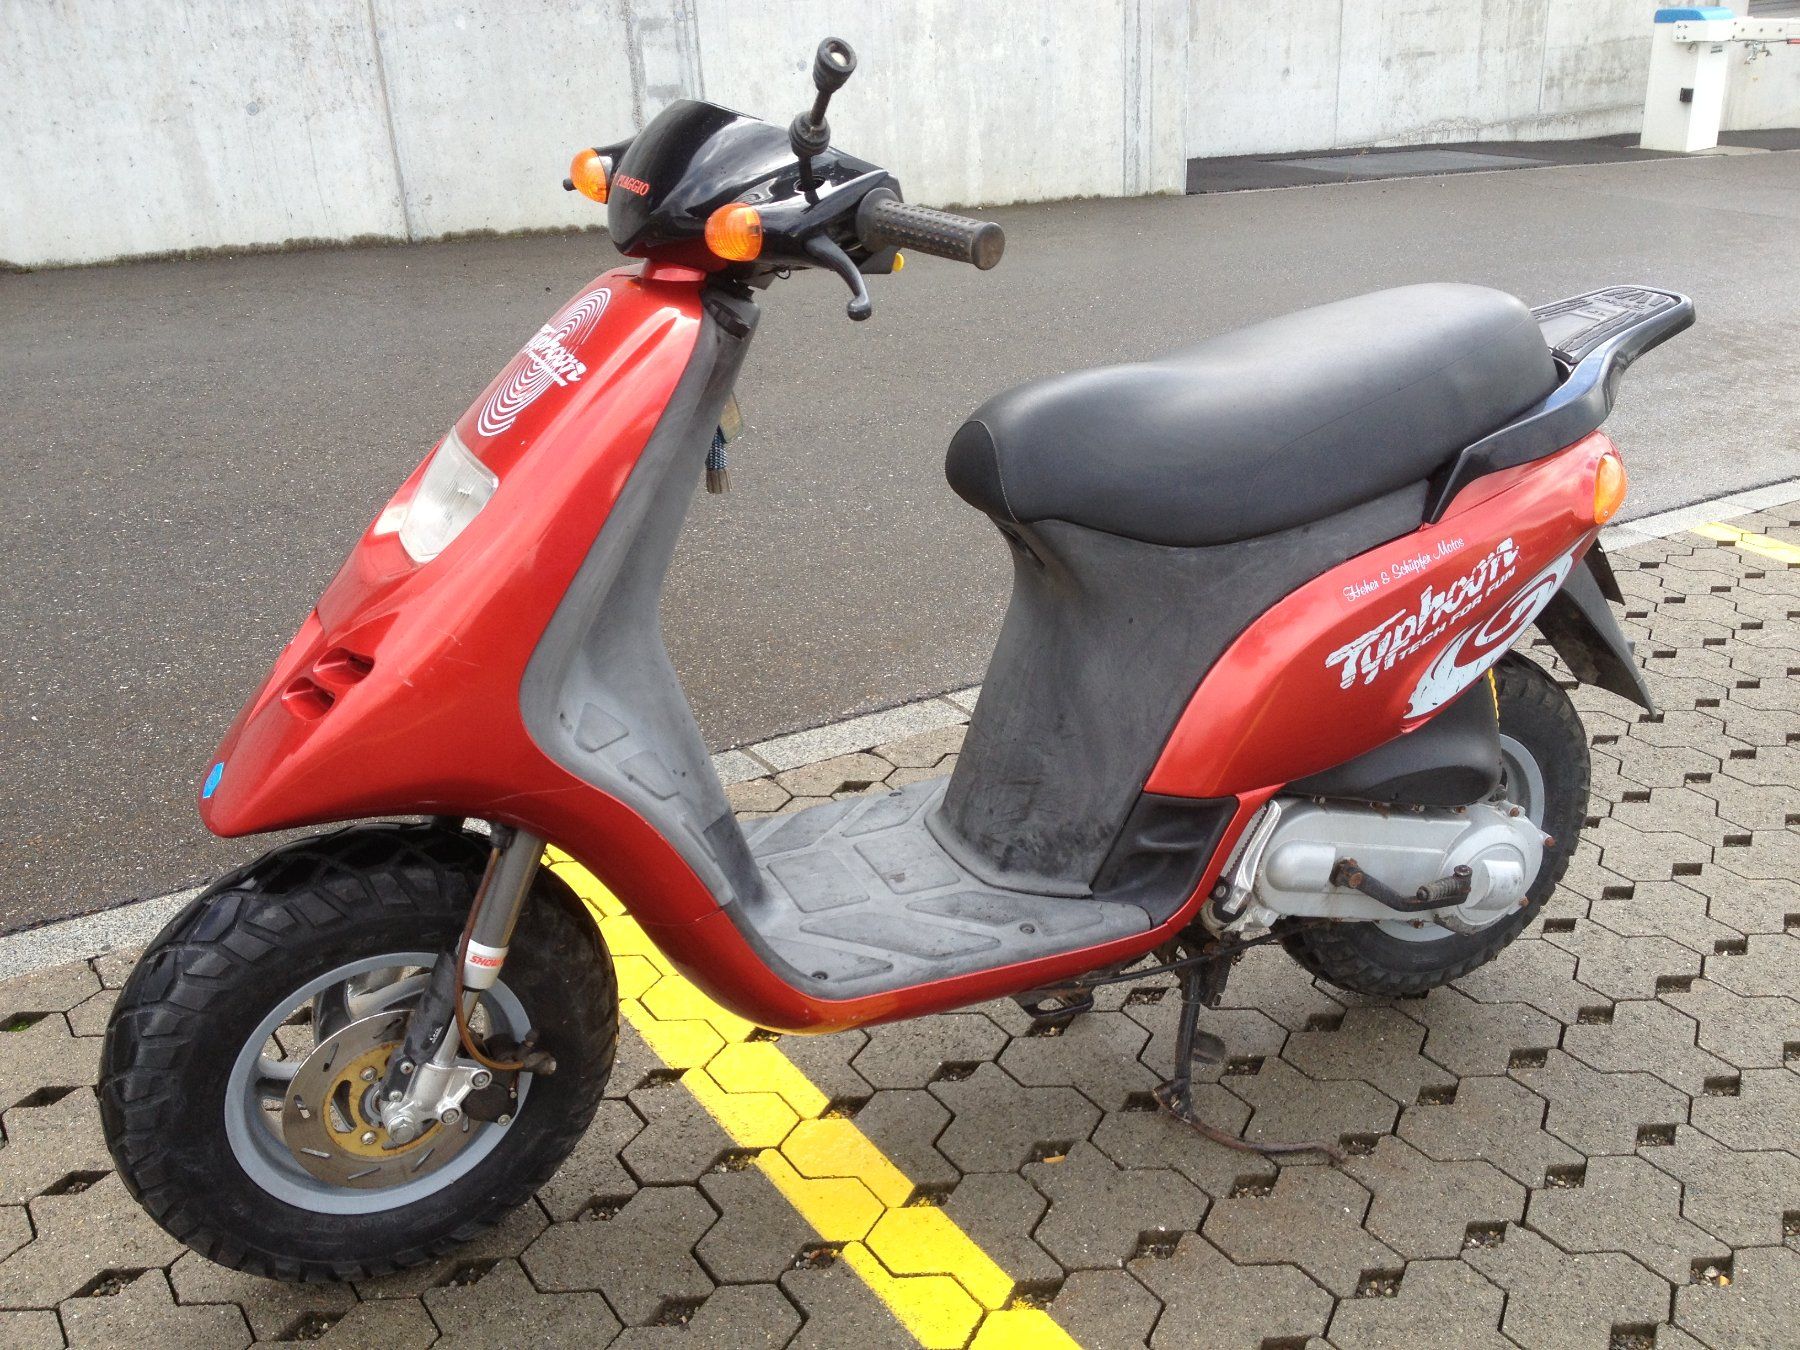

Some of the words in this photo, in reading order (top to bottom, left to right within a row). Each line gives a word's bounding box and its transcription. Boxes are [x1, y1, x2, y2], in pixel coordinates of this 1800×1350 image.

[616, 175, 650, 196] PIAGGIO
[1380, 572, 1390, 584] &
[1391, 553, 1432, 578] Schüpfer
[1433, 538, 1465, 560] Motos
[1325, 537, 1520, 690] Typhoon
[1449, 594, 1482, 626] FOR
[1485, 565, 1516, 597] FUN
